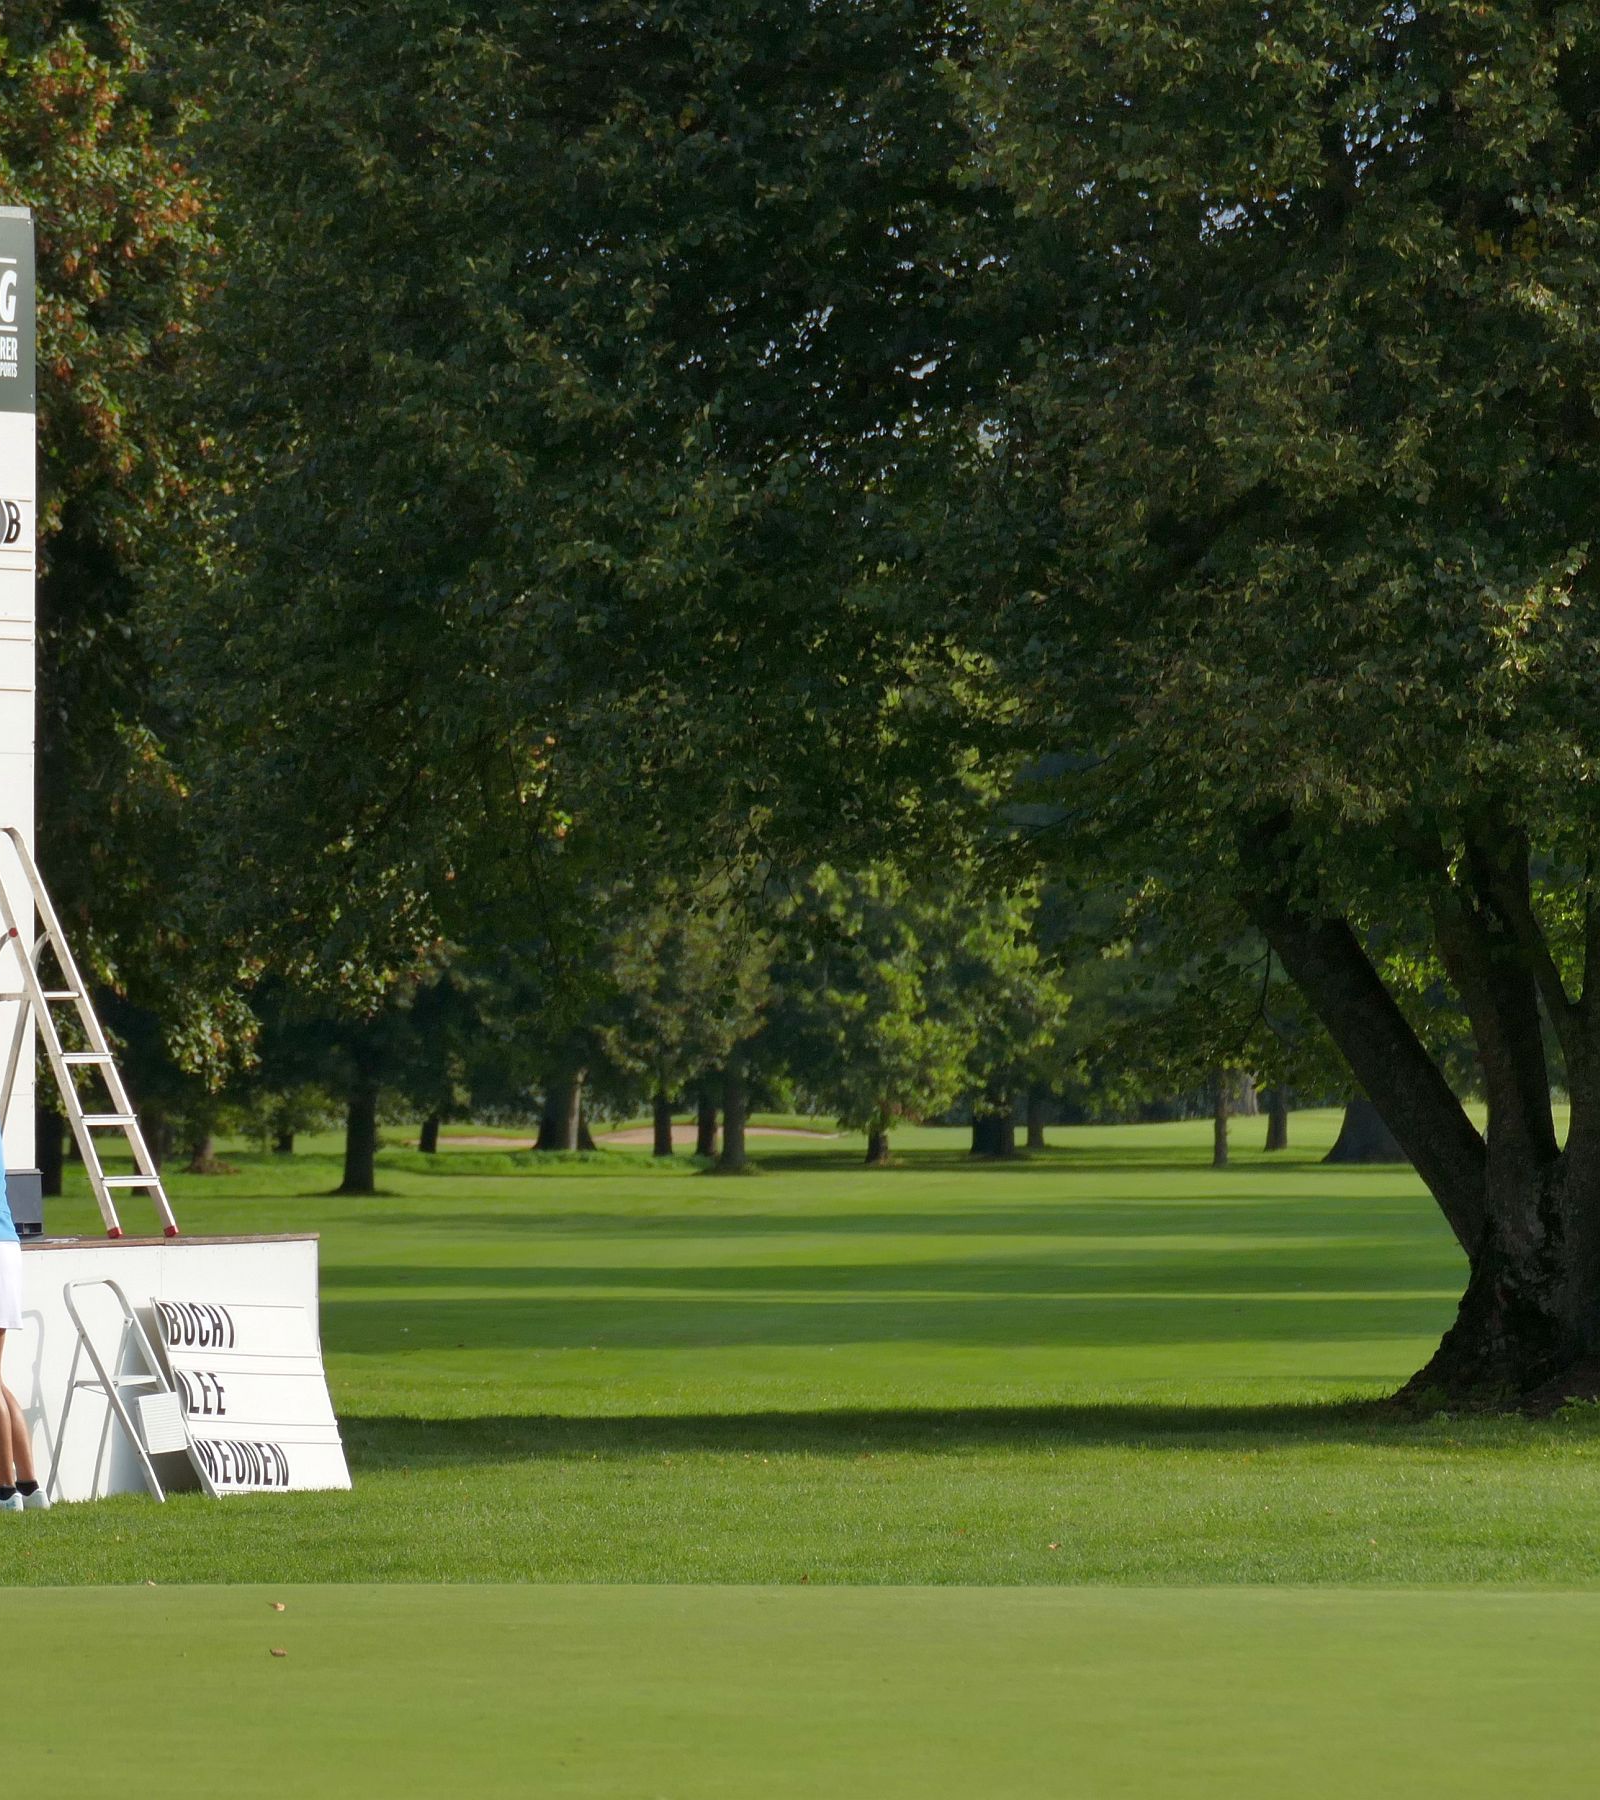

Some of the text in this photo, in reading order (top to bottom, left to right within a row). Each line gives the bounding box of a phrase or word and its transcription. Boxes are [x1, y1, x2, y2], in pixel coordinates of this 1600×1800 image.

[3, 501, 22, 544] B
[159, 1303, 235, 1348] BUCHI
[178, 1370, 226, 1415] LEE
